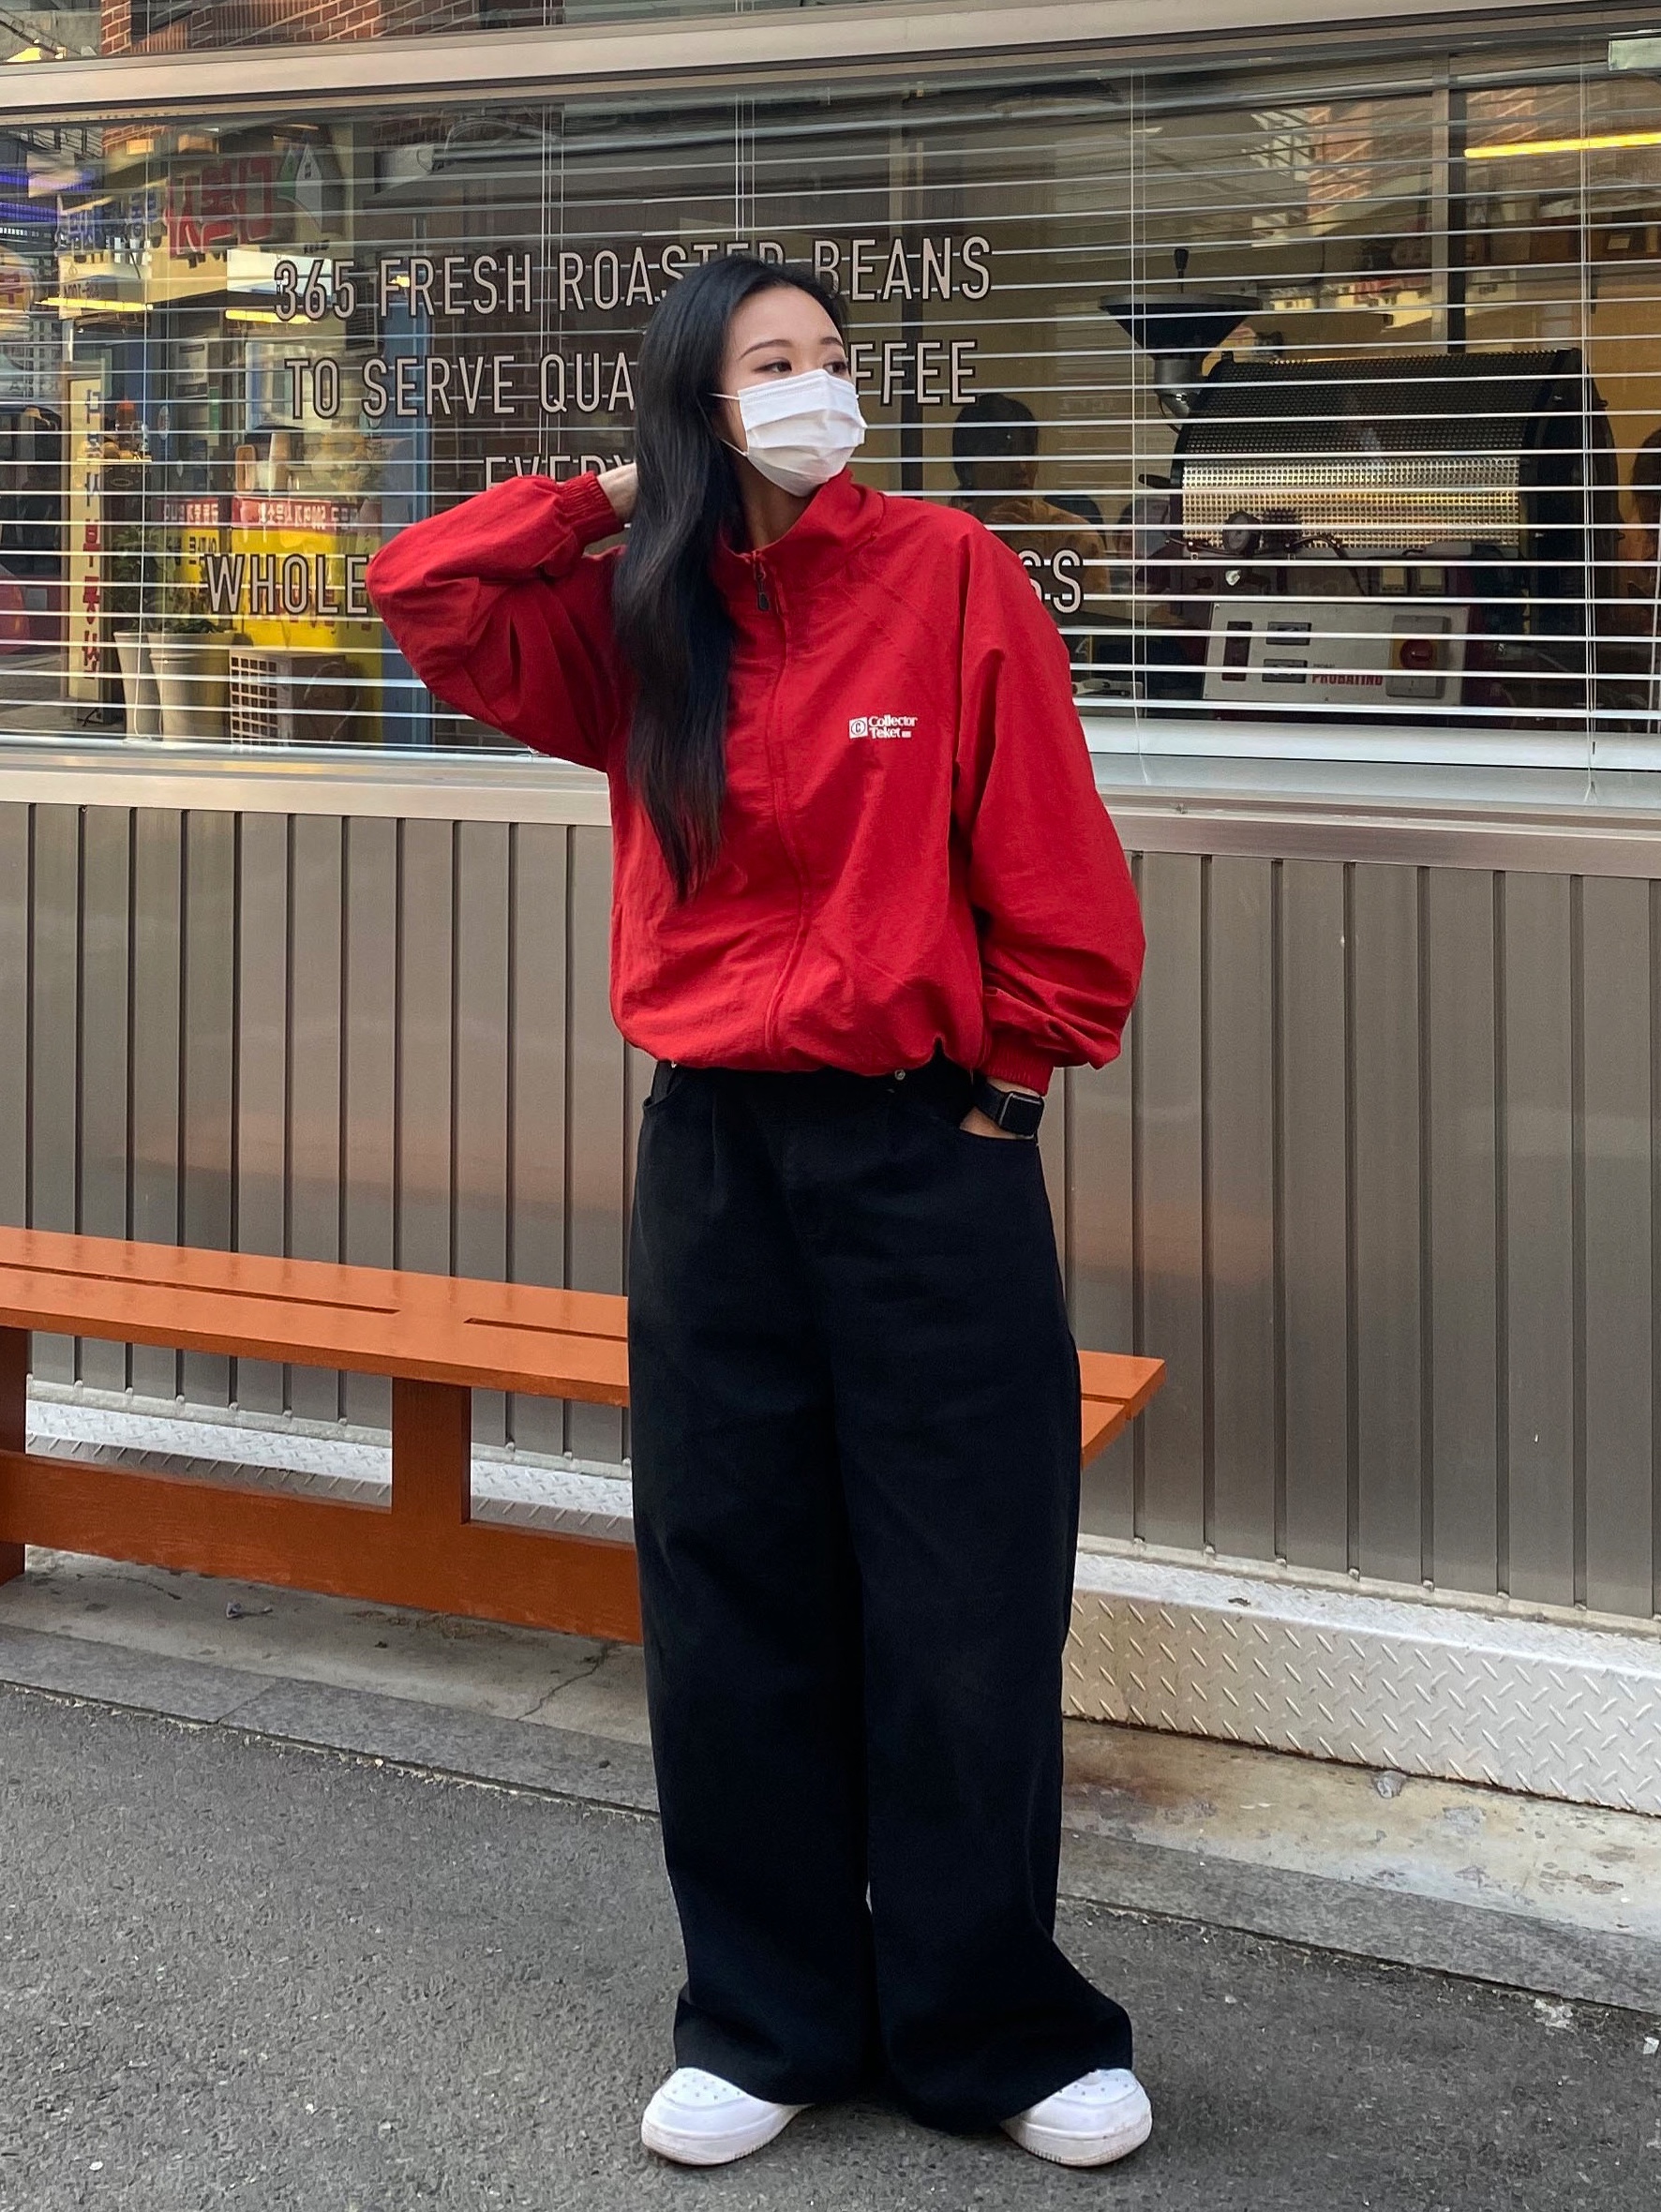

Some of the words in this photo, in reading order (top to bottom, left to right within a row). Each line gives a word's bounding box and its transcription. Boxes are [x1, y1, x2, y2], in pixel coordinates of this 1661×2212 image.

[274, 259, 356, 321] 365
[379, 252, 532, 318] FRESH
[558, 240, 786, 312] ROAS
[813, 235, 993, 302] BEANS
[284, 358, 339, 419] TO
[362, 353, 516, 416] SERVE
[539, 351, 636, 414] QUA
[848, 340, 977, 405] FFEE
[205, 553, 369, 615] WHOLE
[868, 714, 918, 727] Collector
